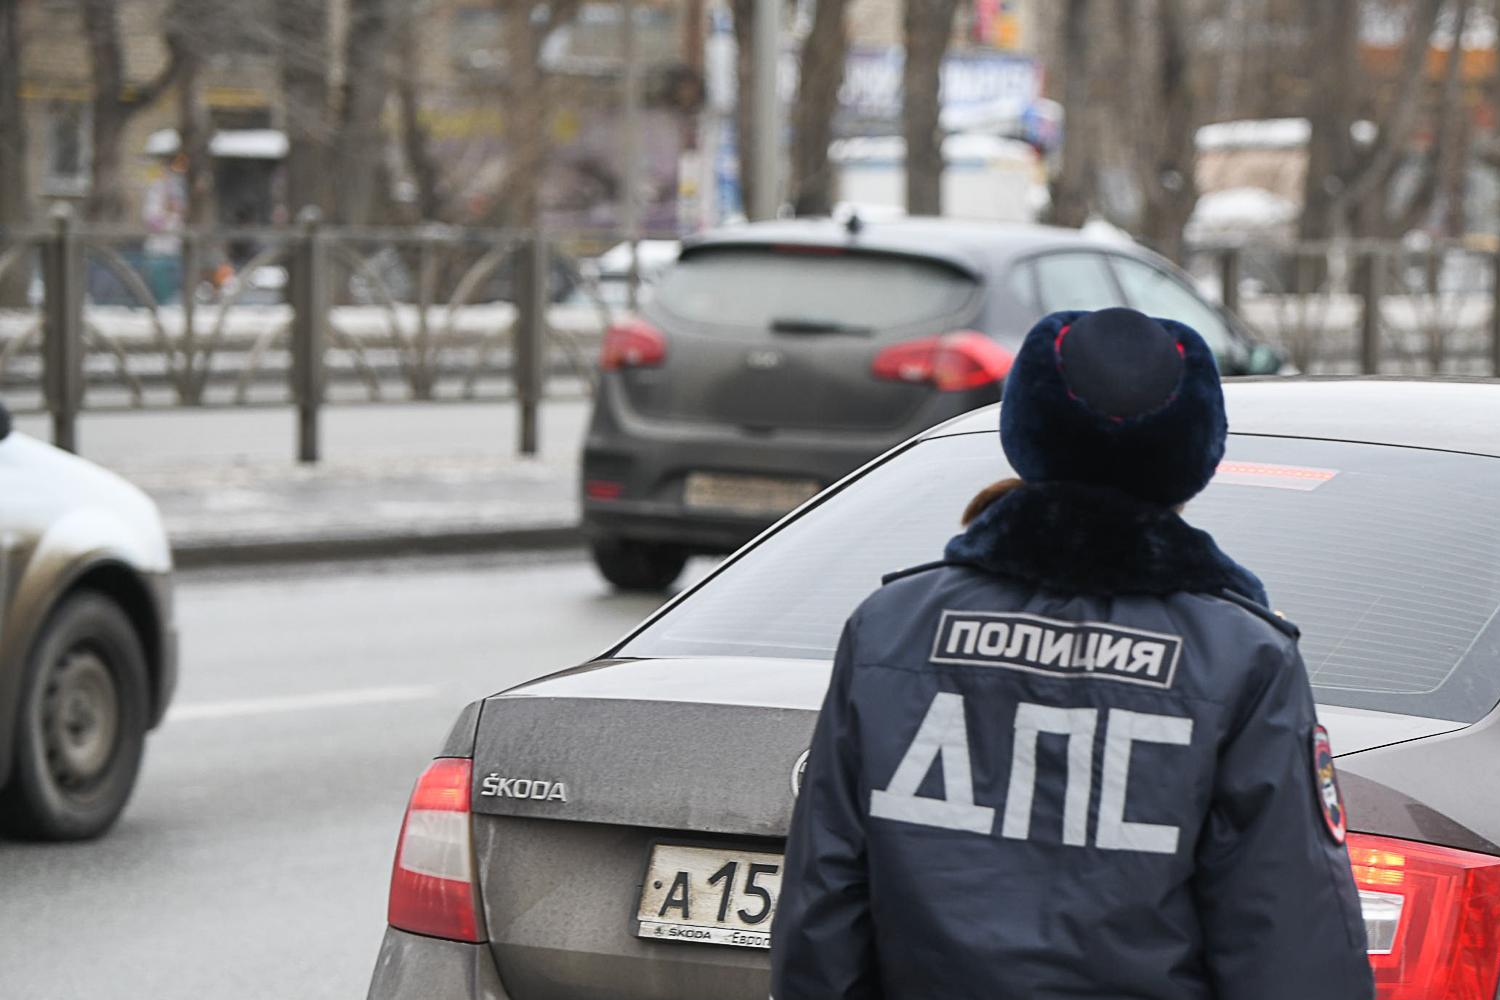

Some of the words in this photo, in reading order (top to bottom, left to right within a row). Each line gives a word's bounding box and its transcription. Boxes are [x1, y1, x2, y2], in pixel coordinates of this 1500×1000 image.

[945, 620, 1166, 677] ПОЛИЦИЯ
[480, 772, 567, 802] ŠKODA
[869, 691, 1193, 855] ДПС
